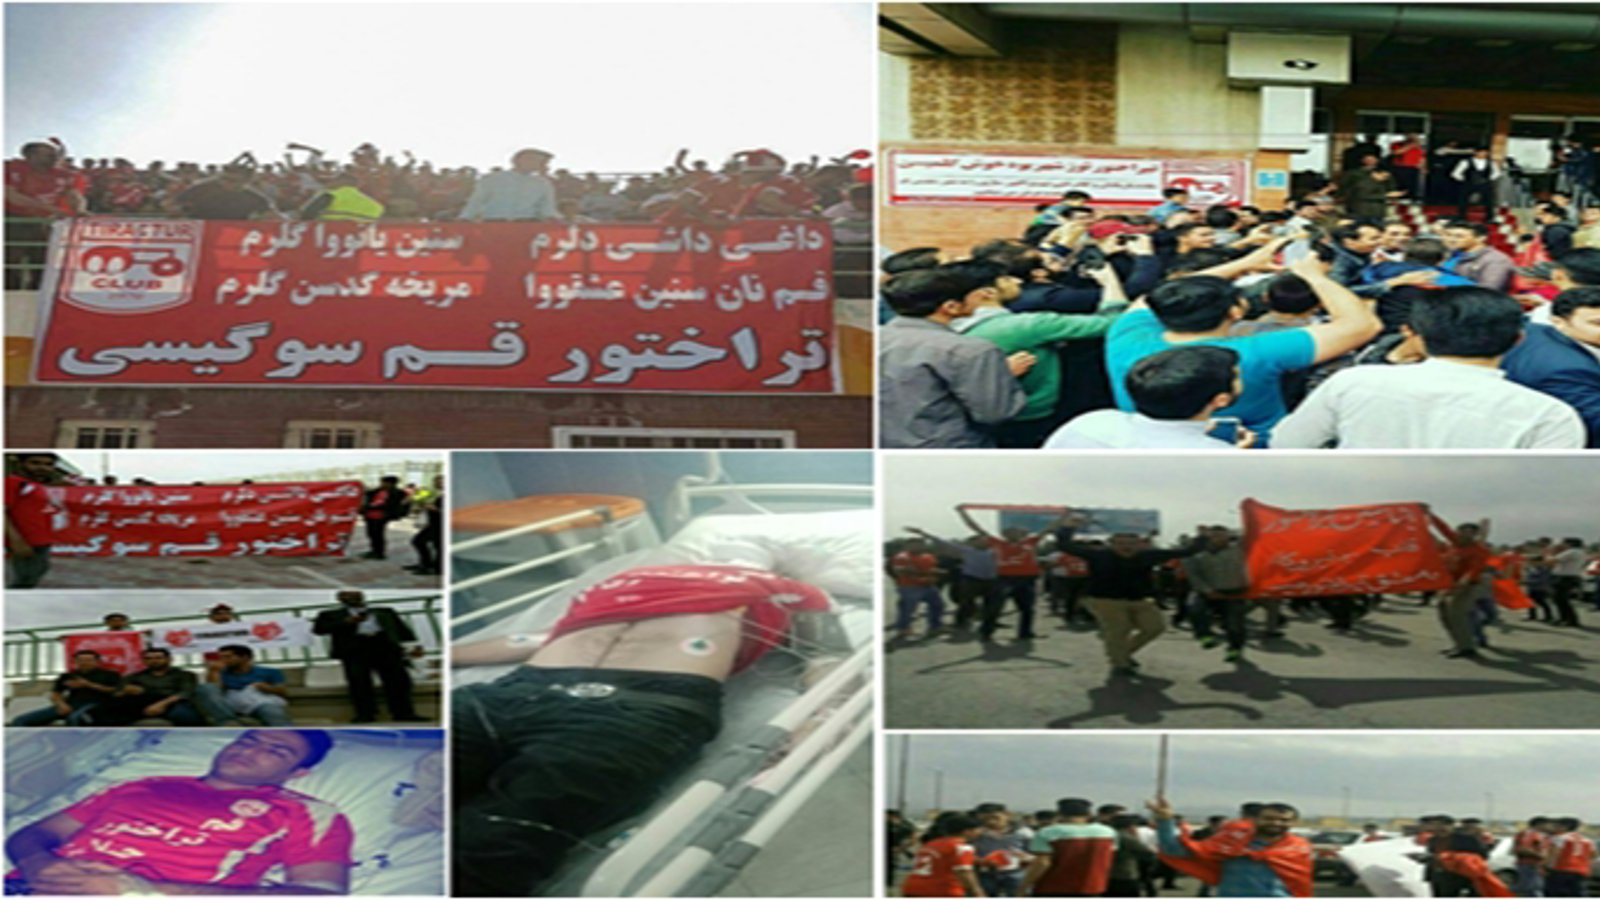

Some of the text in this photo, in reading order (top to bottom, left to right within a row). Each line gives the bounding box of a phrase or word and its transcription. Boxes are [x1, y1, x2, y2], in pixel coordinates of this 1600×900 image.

[239, 222, 307, 257] گلرم
[530, 224, 599, 260] دلرم
[605, 225, 711, 261] داشی
[91, 277, 163, 290] CLUB
[215, 269, 288, 304] گلرم
[382, 320, 526, 379] قم
[546, 327, 829, 387] تراختور
